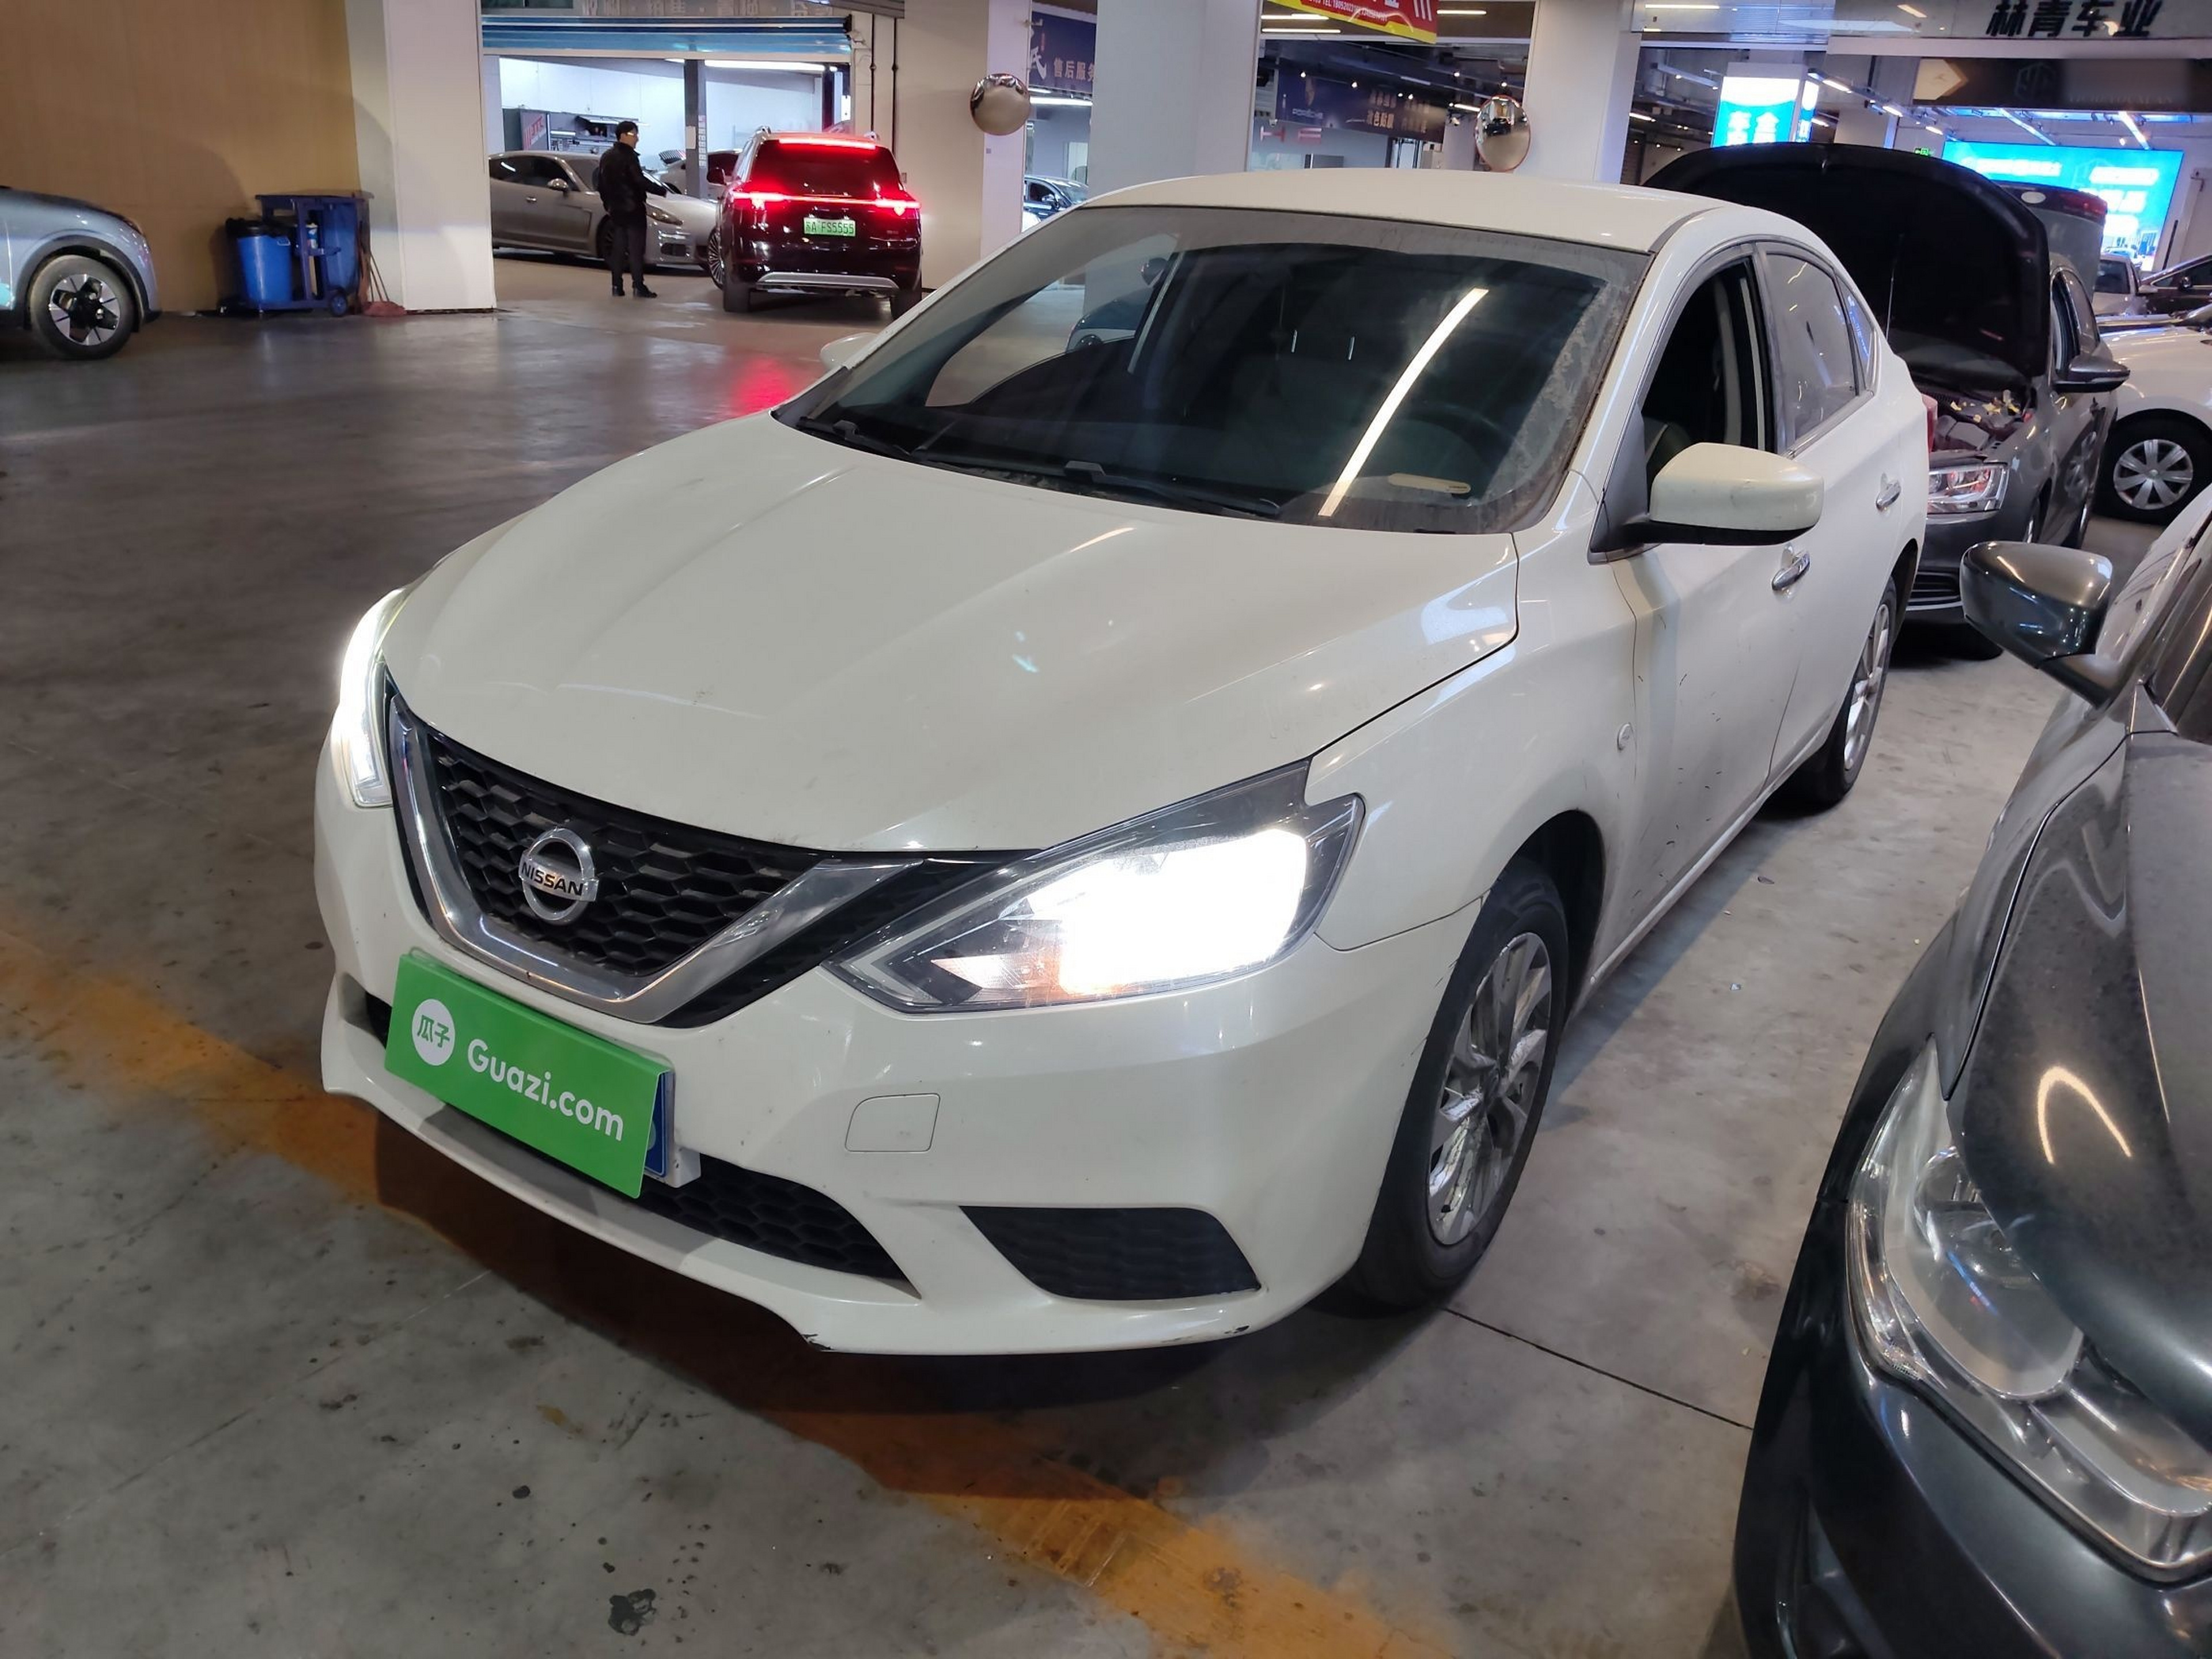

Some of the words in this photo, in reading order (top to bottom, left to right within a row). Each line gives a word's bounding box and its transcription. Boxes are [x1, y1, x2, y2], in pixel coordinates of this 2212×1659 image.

[1986, 0, 2162, 37] 林青车业
[521, 862, 584, 896] NISSAN
[417, 1015, 450, 1047] 瓜子
[467, 1039, 624, 1141] Guazi.com
